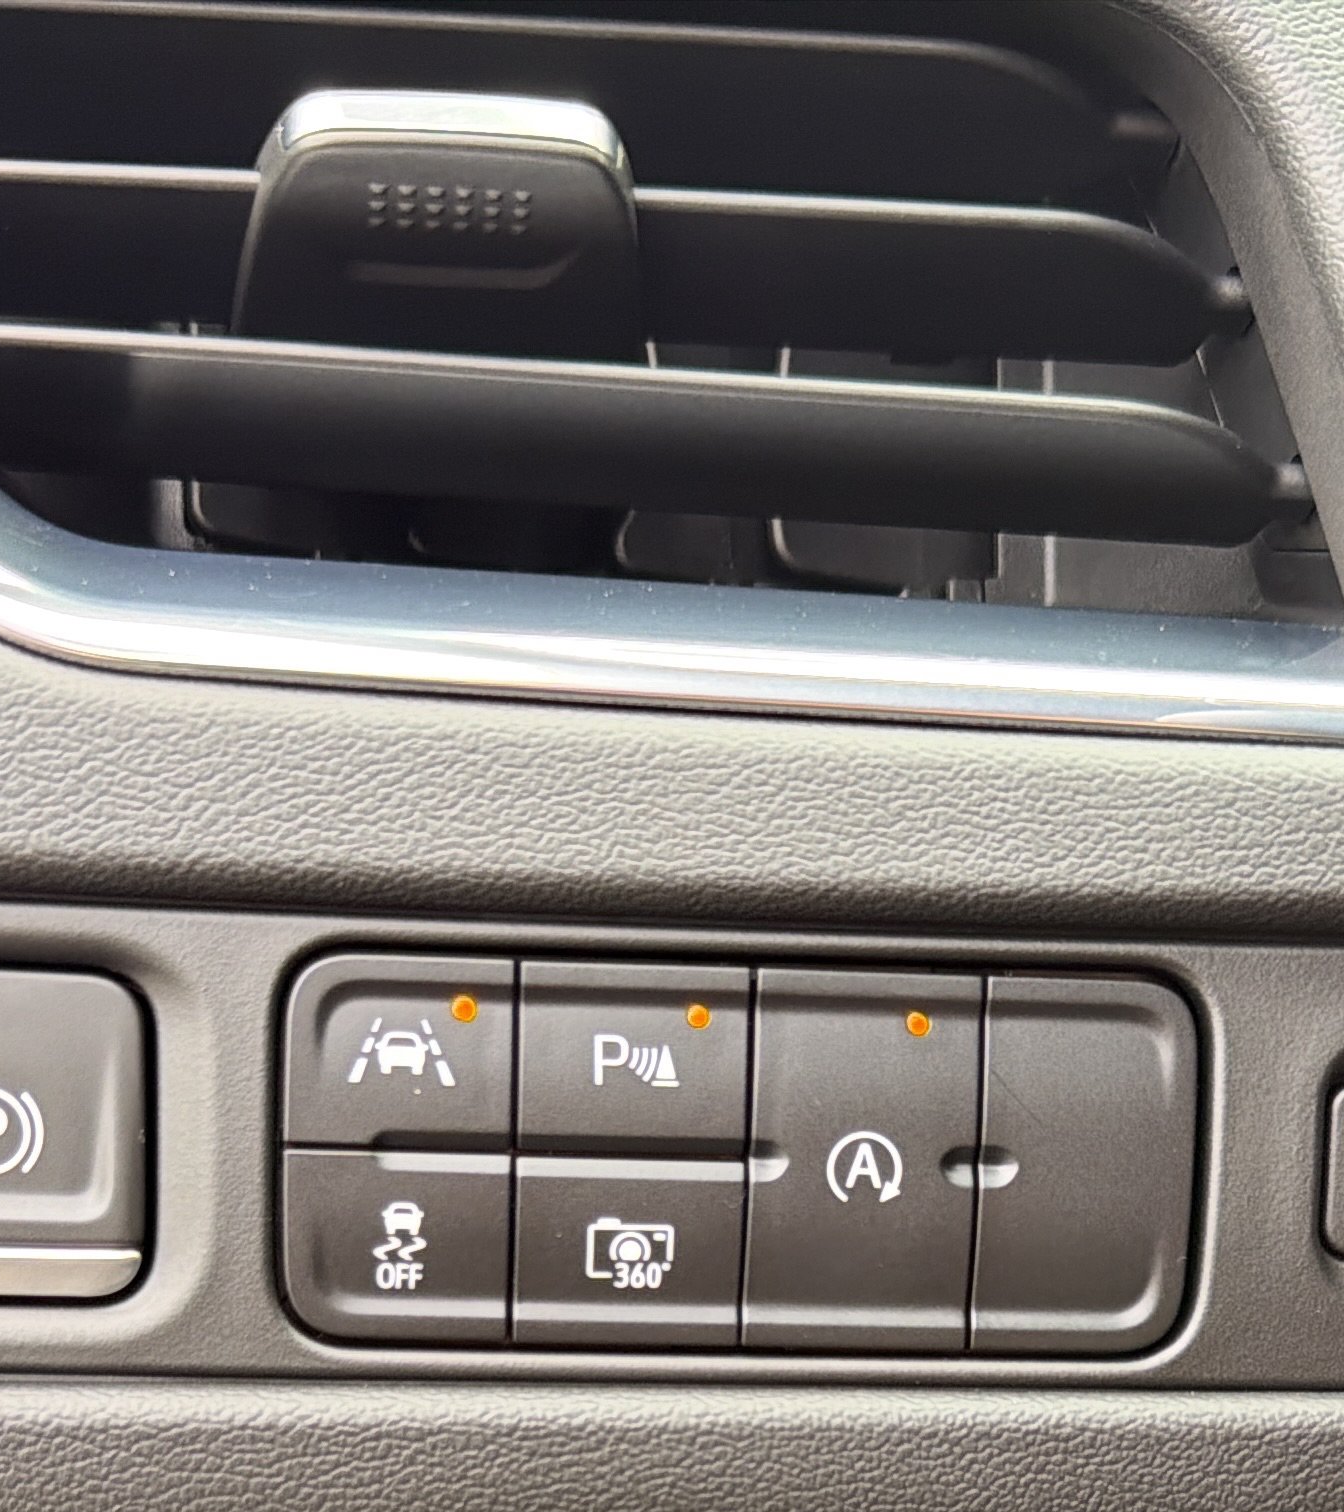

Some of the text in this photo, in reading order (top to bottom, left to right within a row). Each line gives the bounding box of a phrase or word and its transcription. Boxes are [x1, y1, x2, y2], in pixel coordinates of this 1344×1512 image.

[594, 1034, 631, 1086] P
[845, 1142, 882, 1189] A
[375, 1263, 424, 1290] OFF
